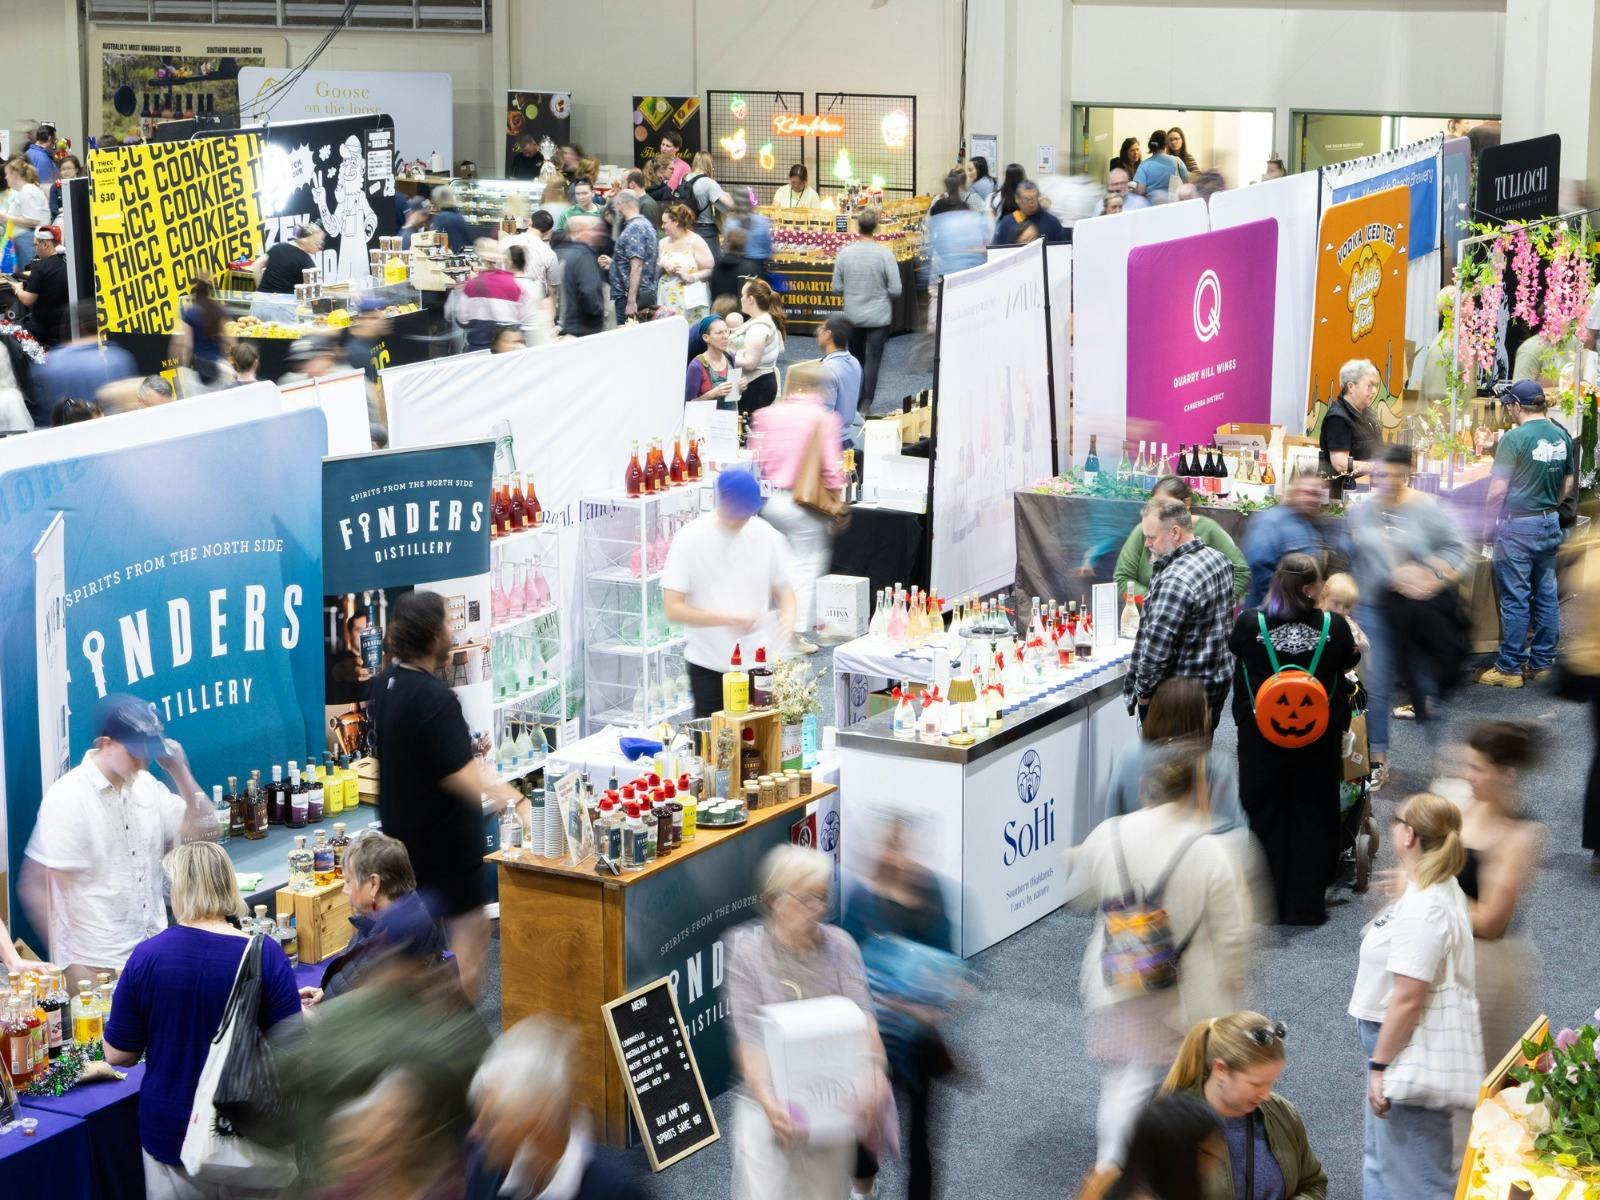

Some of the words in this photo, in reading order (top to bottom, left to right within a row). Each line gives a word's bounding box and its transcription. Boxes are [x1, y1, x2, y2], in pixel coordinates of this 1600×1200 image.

[207, 46, 227, 54] SOUTHERN
[316, 81, 369, 99] Goose
[304, 104, 321, 113] on
[325, 102, 345, 113] the
[350, 102, 382, 113] loose
[153, 137, 238, 192] COOKIES
[101, 193, 115, 203] $30
[160, 165, 244, 225] COOKIES
[1494, 166, 1547, 201] TULLOCH
[103, 235, 162, 286] THICC
[166, 198, 248, 259] COOKIES
[1337, 228, 1362, 264] VODKA
[1365, 223, 1381, 241] ICED
[1383, 224, 1395, 248] TEA
[110, 268, 168, 318] THICC
[1193, 269, 1221, 342] Q
[1174, 371, 1199, 388] QUARRY
[1201, 366, 1214, 379] HILL
[1216, 359, 1236, 374] WINES
[1184, 399, 1205, 412] CANBERRA
[1207, 392, 1224, 404] DISTRICT
[350, 487, 381, 502] SPIRITS
[383, 483, 406, 493] FROM
[427, 479, 453, 487] NORTH
[339, 500, 483, 550] FINDERS
[375, 542, 452, 563] DISTILLERY
[65, 572, 120, 607] SPIRITS
[126, 555, 165, 580] FROM
[170, 548, 197, 565] THE
[203, 540, 249, 558] NORTH
[254, 539, 284, 552] SIDE
[67, 584, 303, 715] INDERS
[1004, 798, 1055, 866] SoHi
[660, 928, 690, 956] SPIRITS
[692, 913, 712, 933] FROM
[715, 904, 730, 919] THE
[732, 895, 757, 911] NORTH
[631, 997, 647, 1012] MENU
[685, 998, 732, 1040] DISTILL
[625, 1043, 648, 1060] AUSTRALIAN
[648, 1039, 656, 1048] DRY
[632, 1066, 654, 1083] BLACKBERRY
[636, 1082, 652, 1095] BARREL
[656, 1114, 667, 1127] BUY
[668, 1108, 678, 1121] ANY
[678, 1102, 690, 1114] TWO
[656, 1128, 677, 1145] SPIRITS
[677, 1119, 692, 1133] SAVE
